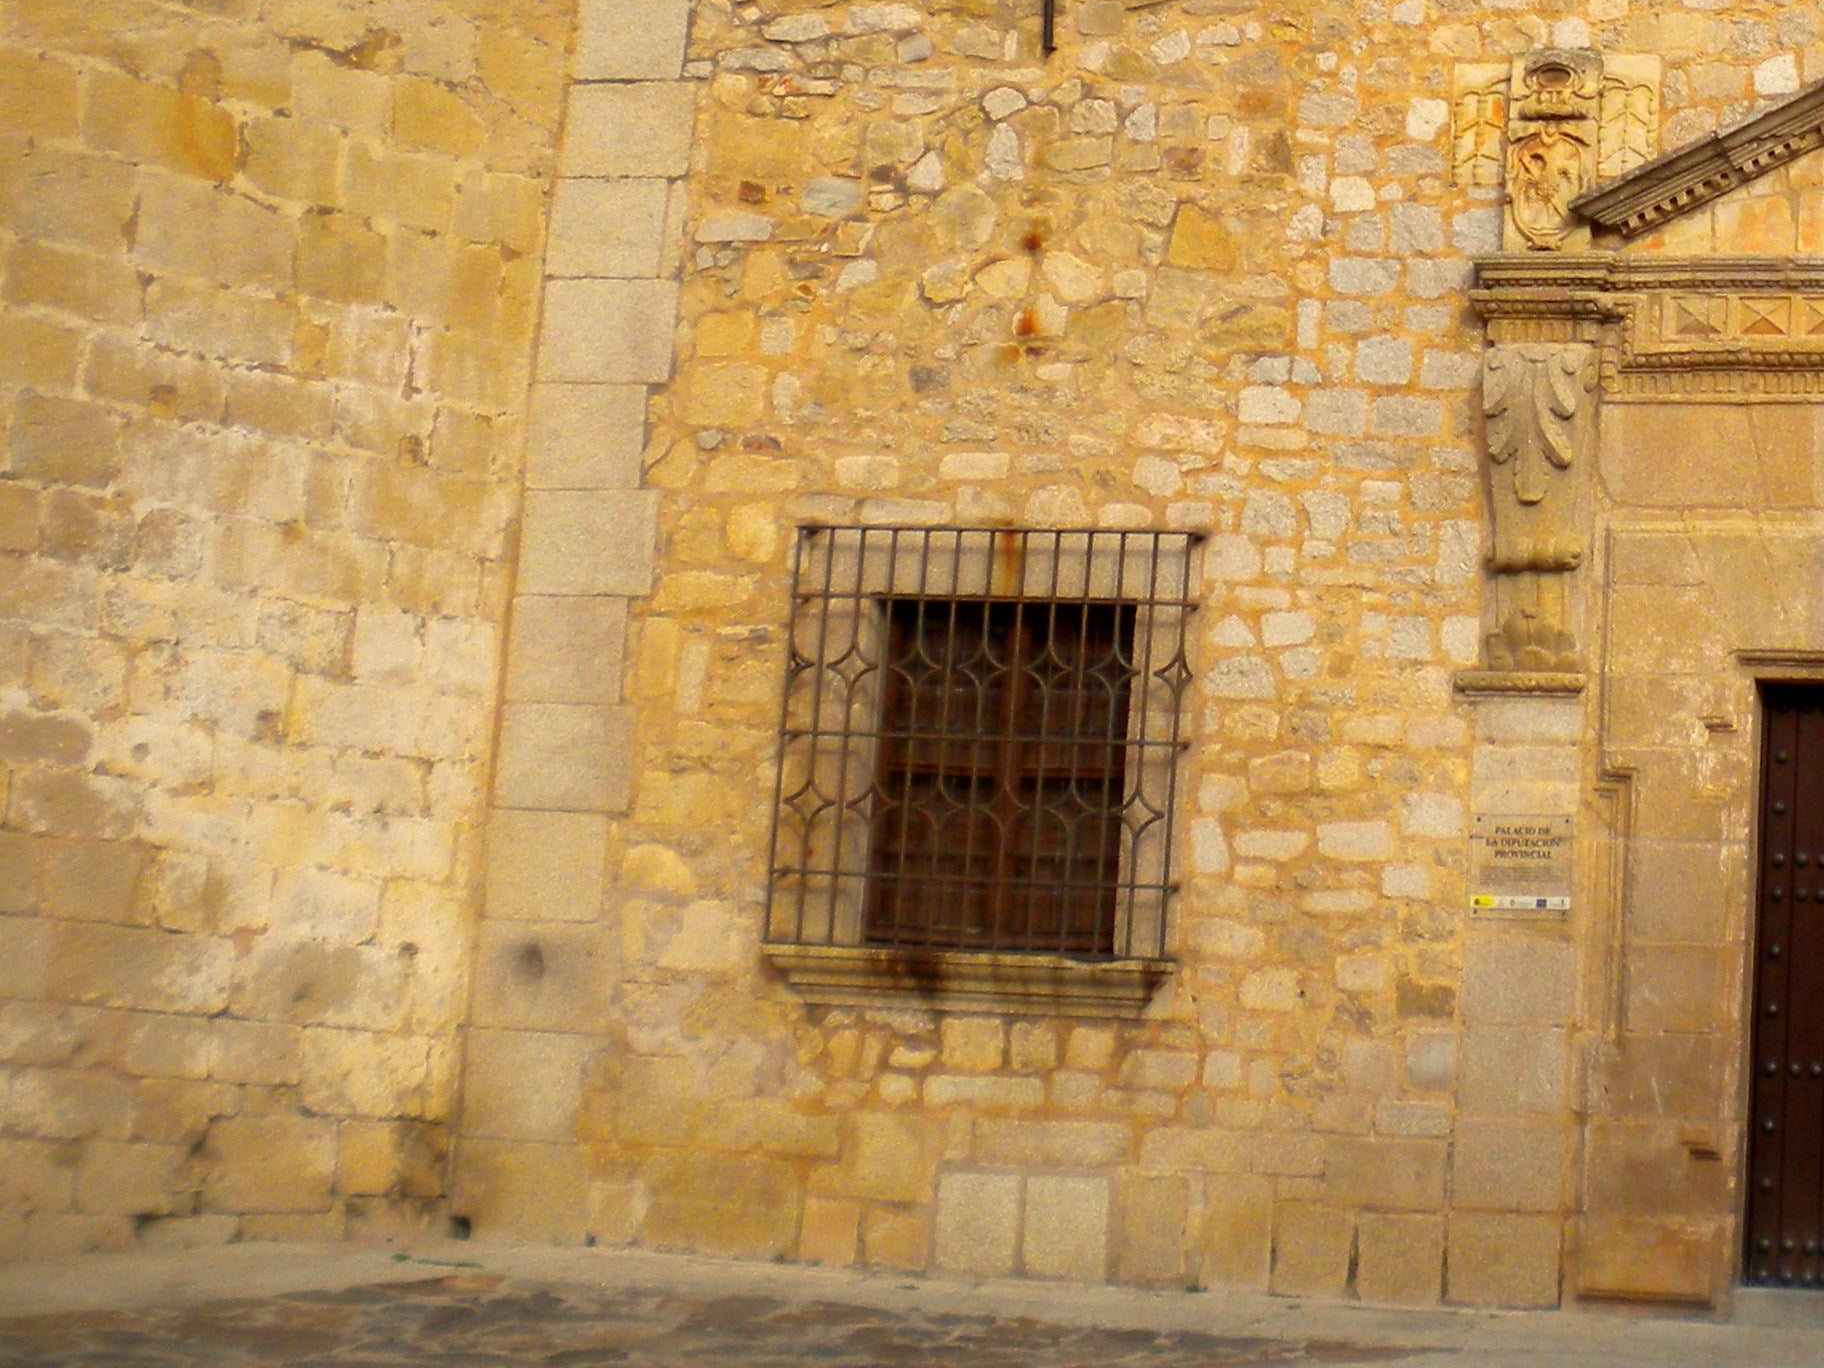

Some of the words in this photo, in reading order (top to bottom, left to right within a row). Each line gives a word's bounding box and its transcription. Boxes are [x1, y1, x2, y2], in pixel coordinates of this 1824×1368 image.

[1495, 827, 1536, 835] PALACIO
[1486, 838, 1498, 847] LA
[1495, 850, 1553, 859] PROVINCIAL
